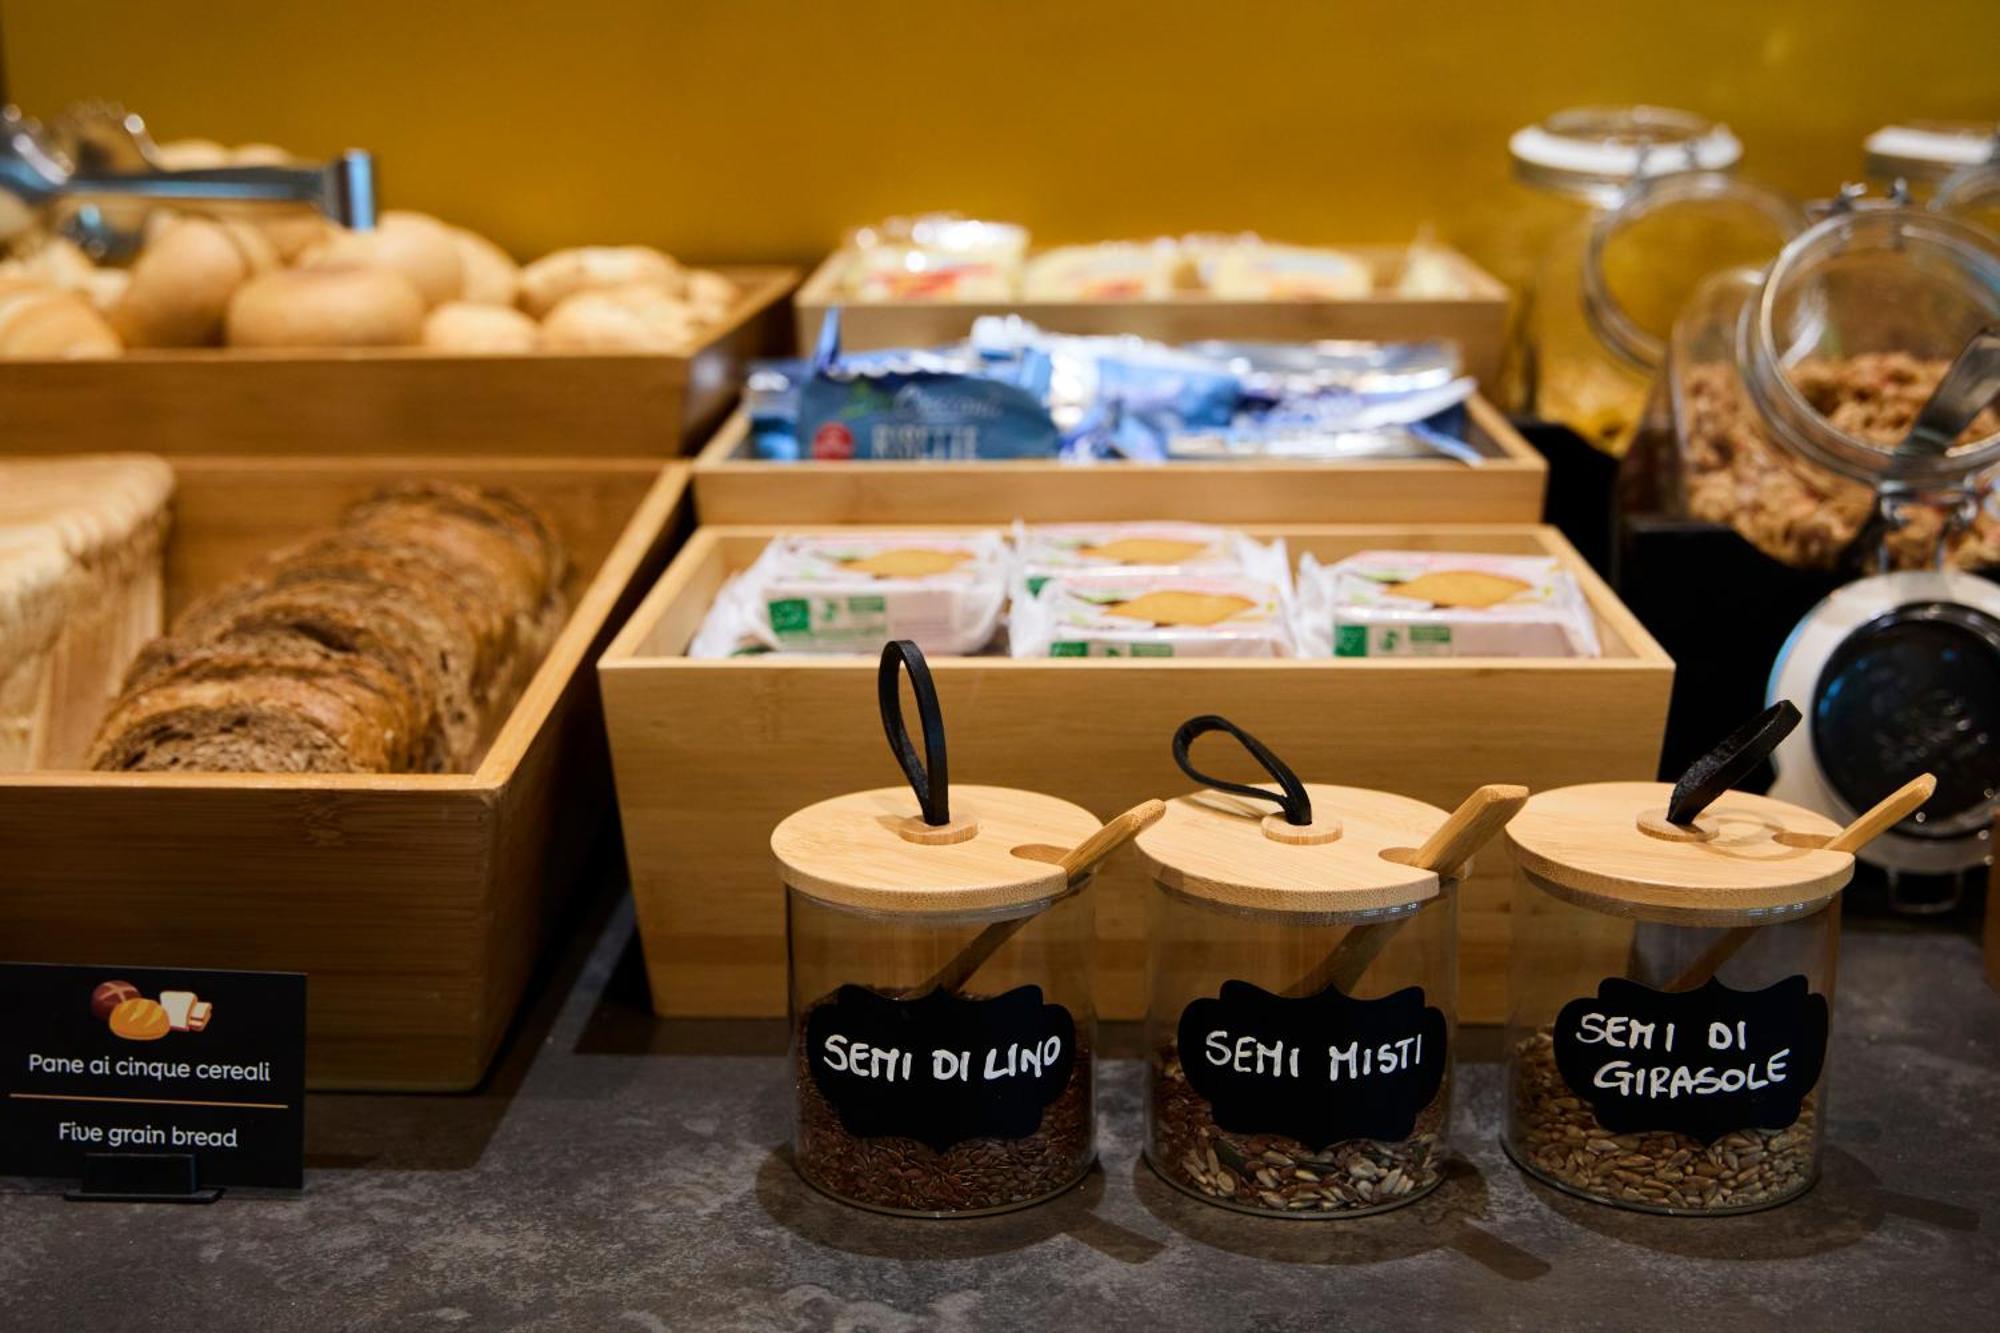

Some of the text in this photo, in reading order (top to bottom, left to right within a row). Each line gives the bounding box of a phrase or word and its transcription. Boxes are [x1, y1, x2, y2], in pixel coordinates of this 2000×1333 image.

[1575, 1012, 1747, 1052] SEMI DI
[29, 1054, 271, 1081] Pane ai cinque cereali
[823, 1034, 1062, 1083] SEMI DI LINO
[1205, 1030, 1423, 1082] SEMI MISTI
[1593, 1047, 1791, 1099] GIRASOLE
[59, 1121, 238, 1147] Five grain bread
